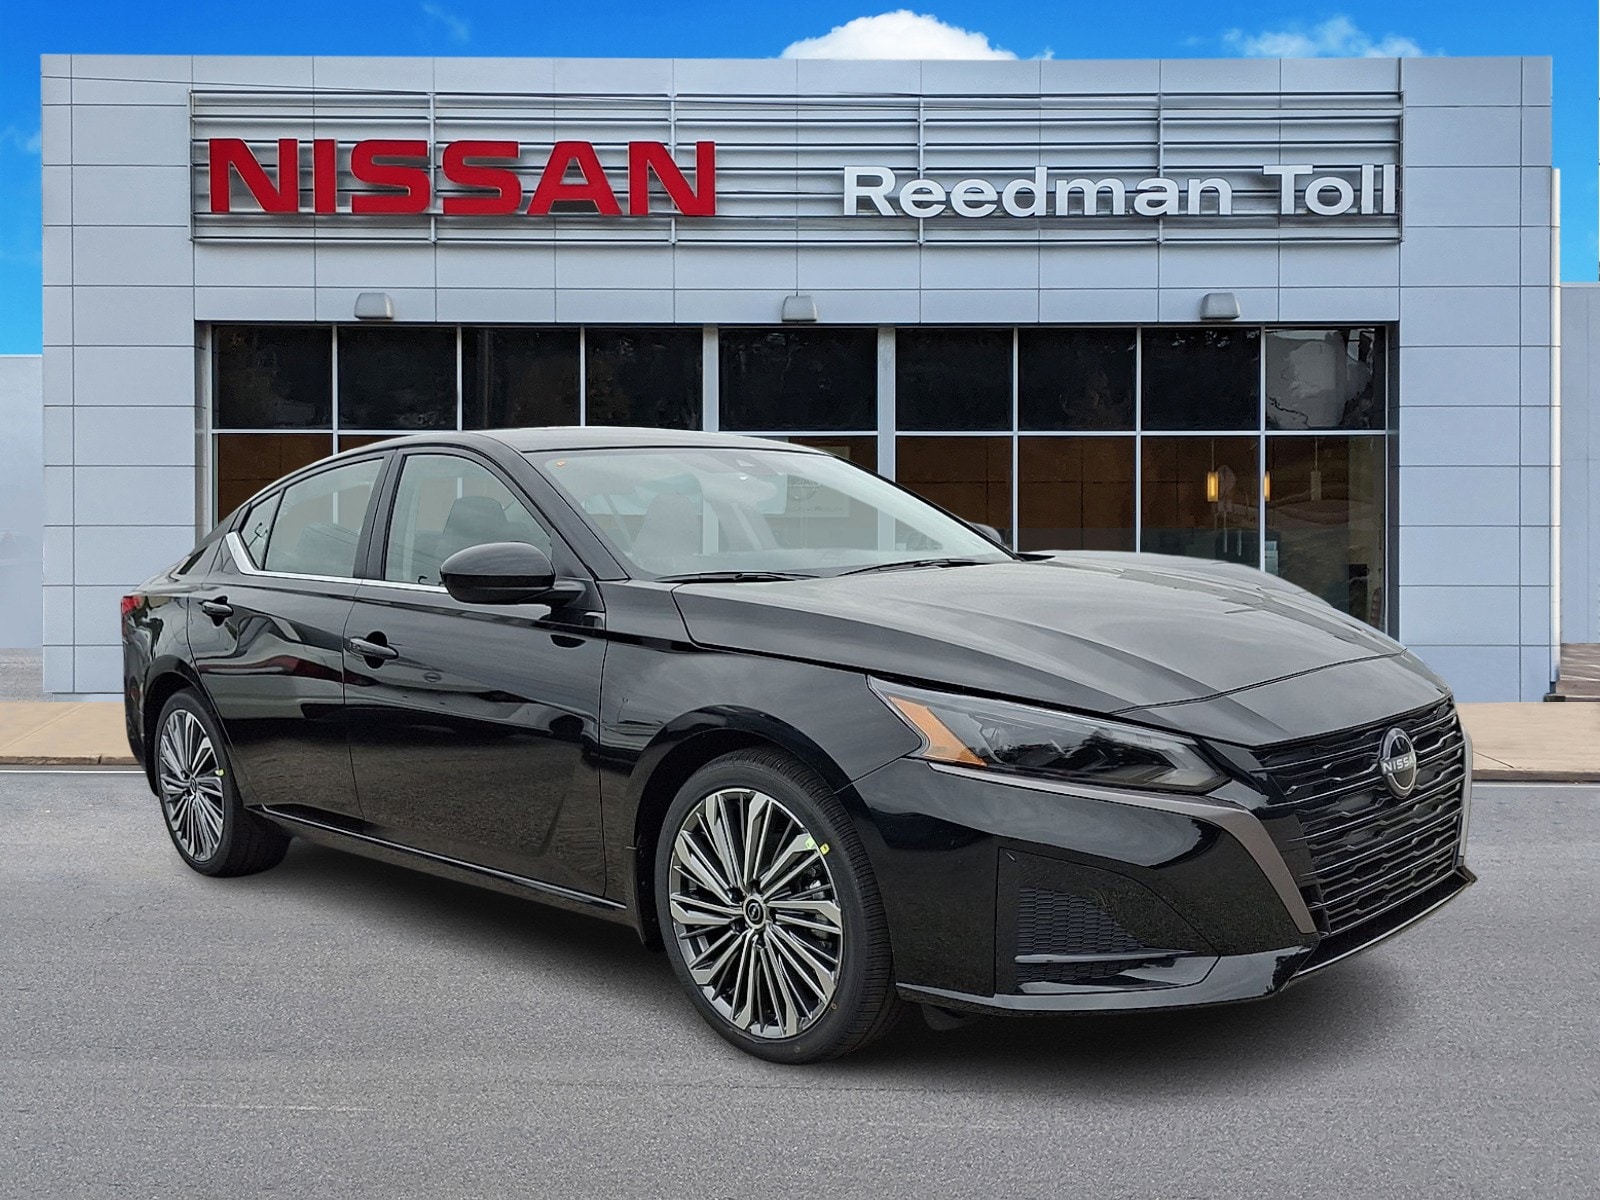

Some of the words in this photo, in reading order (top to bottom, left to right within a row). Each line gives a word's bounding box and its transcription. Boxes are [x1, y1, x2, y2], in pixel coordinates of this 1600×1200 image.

[208, 137, 717, 216] NISSAN
[842, 165, 1233, 218] Reedman
[1262, 163, 1397, 216] Toll
[1382, 755, 1415, 773] NISSA
